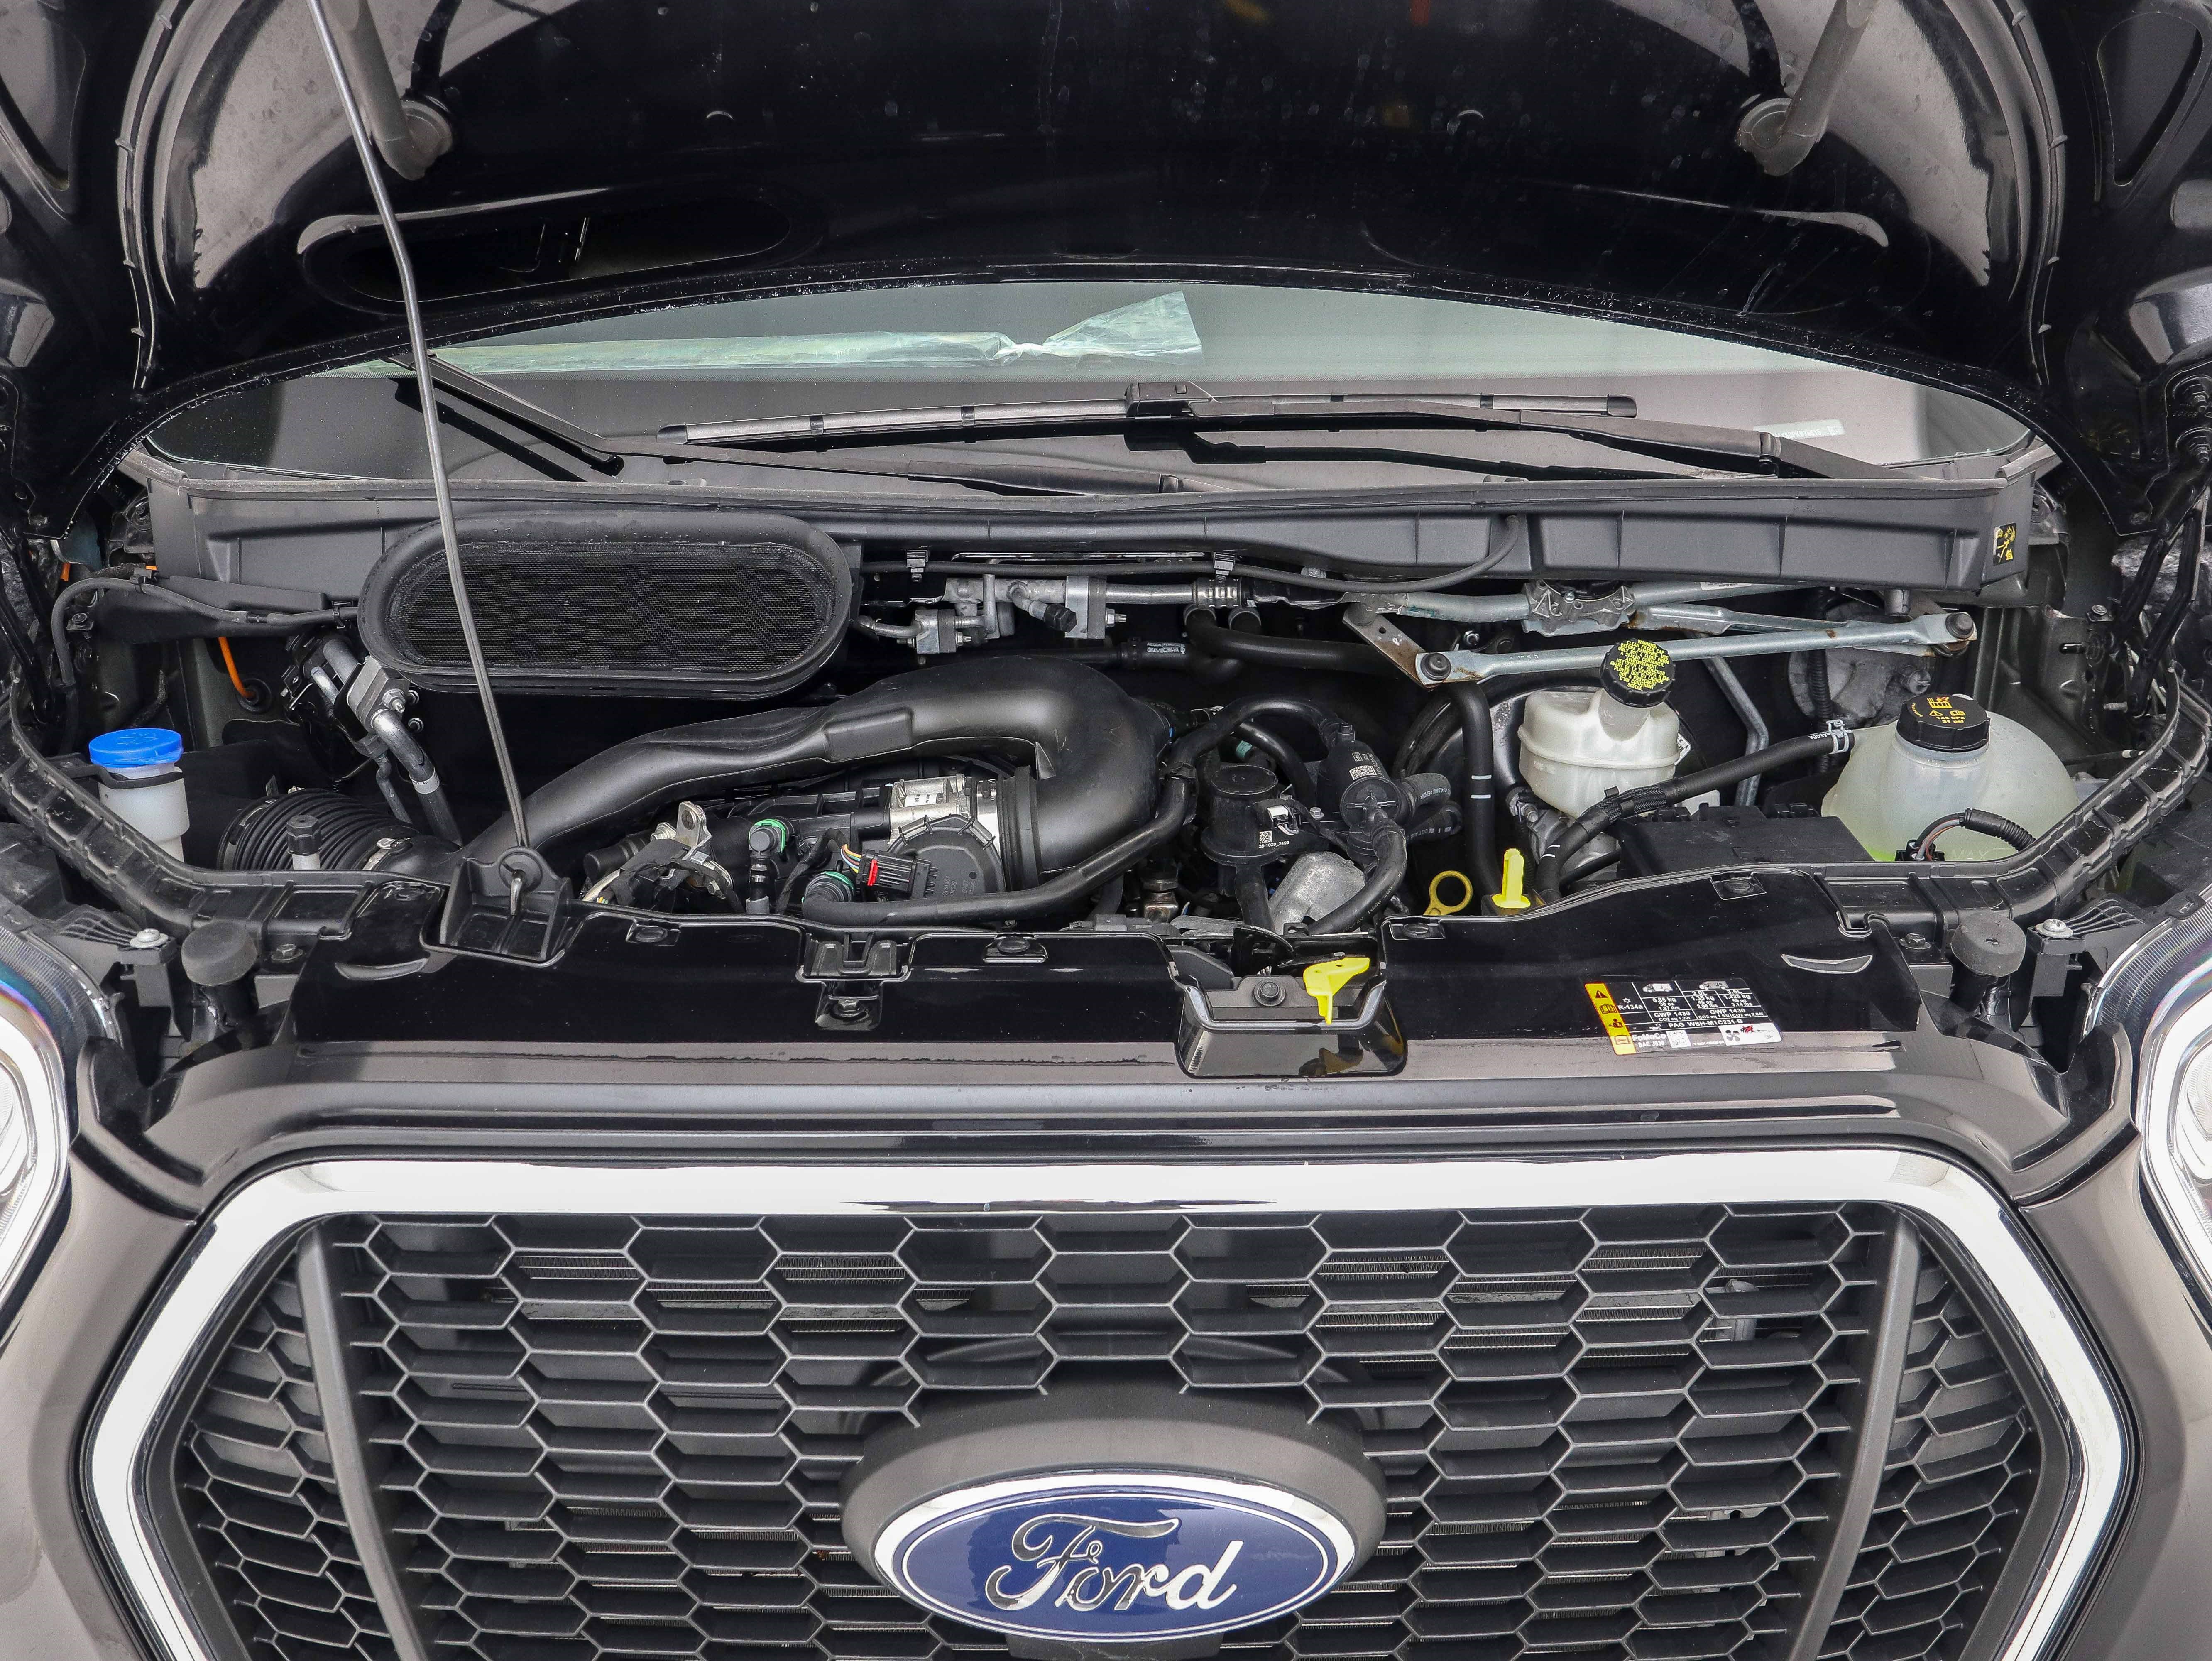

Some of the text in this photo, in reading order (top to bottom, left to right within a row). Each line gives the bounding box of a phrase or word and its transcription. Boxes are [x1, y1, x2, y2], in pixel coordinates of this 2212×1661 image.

[1616, 658, 1637, 667] NETTOYER
[1646, 667, 1666, 676] BOUCHON
[1631, 679, 1654, 689] CONTENANT
[1633, 676, 1657, 686] PROVENANT
[1632, 1033, 1666, 1041] FoMoCo
[985, 1513, 1244, 1611] Ford
